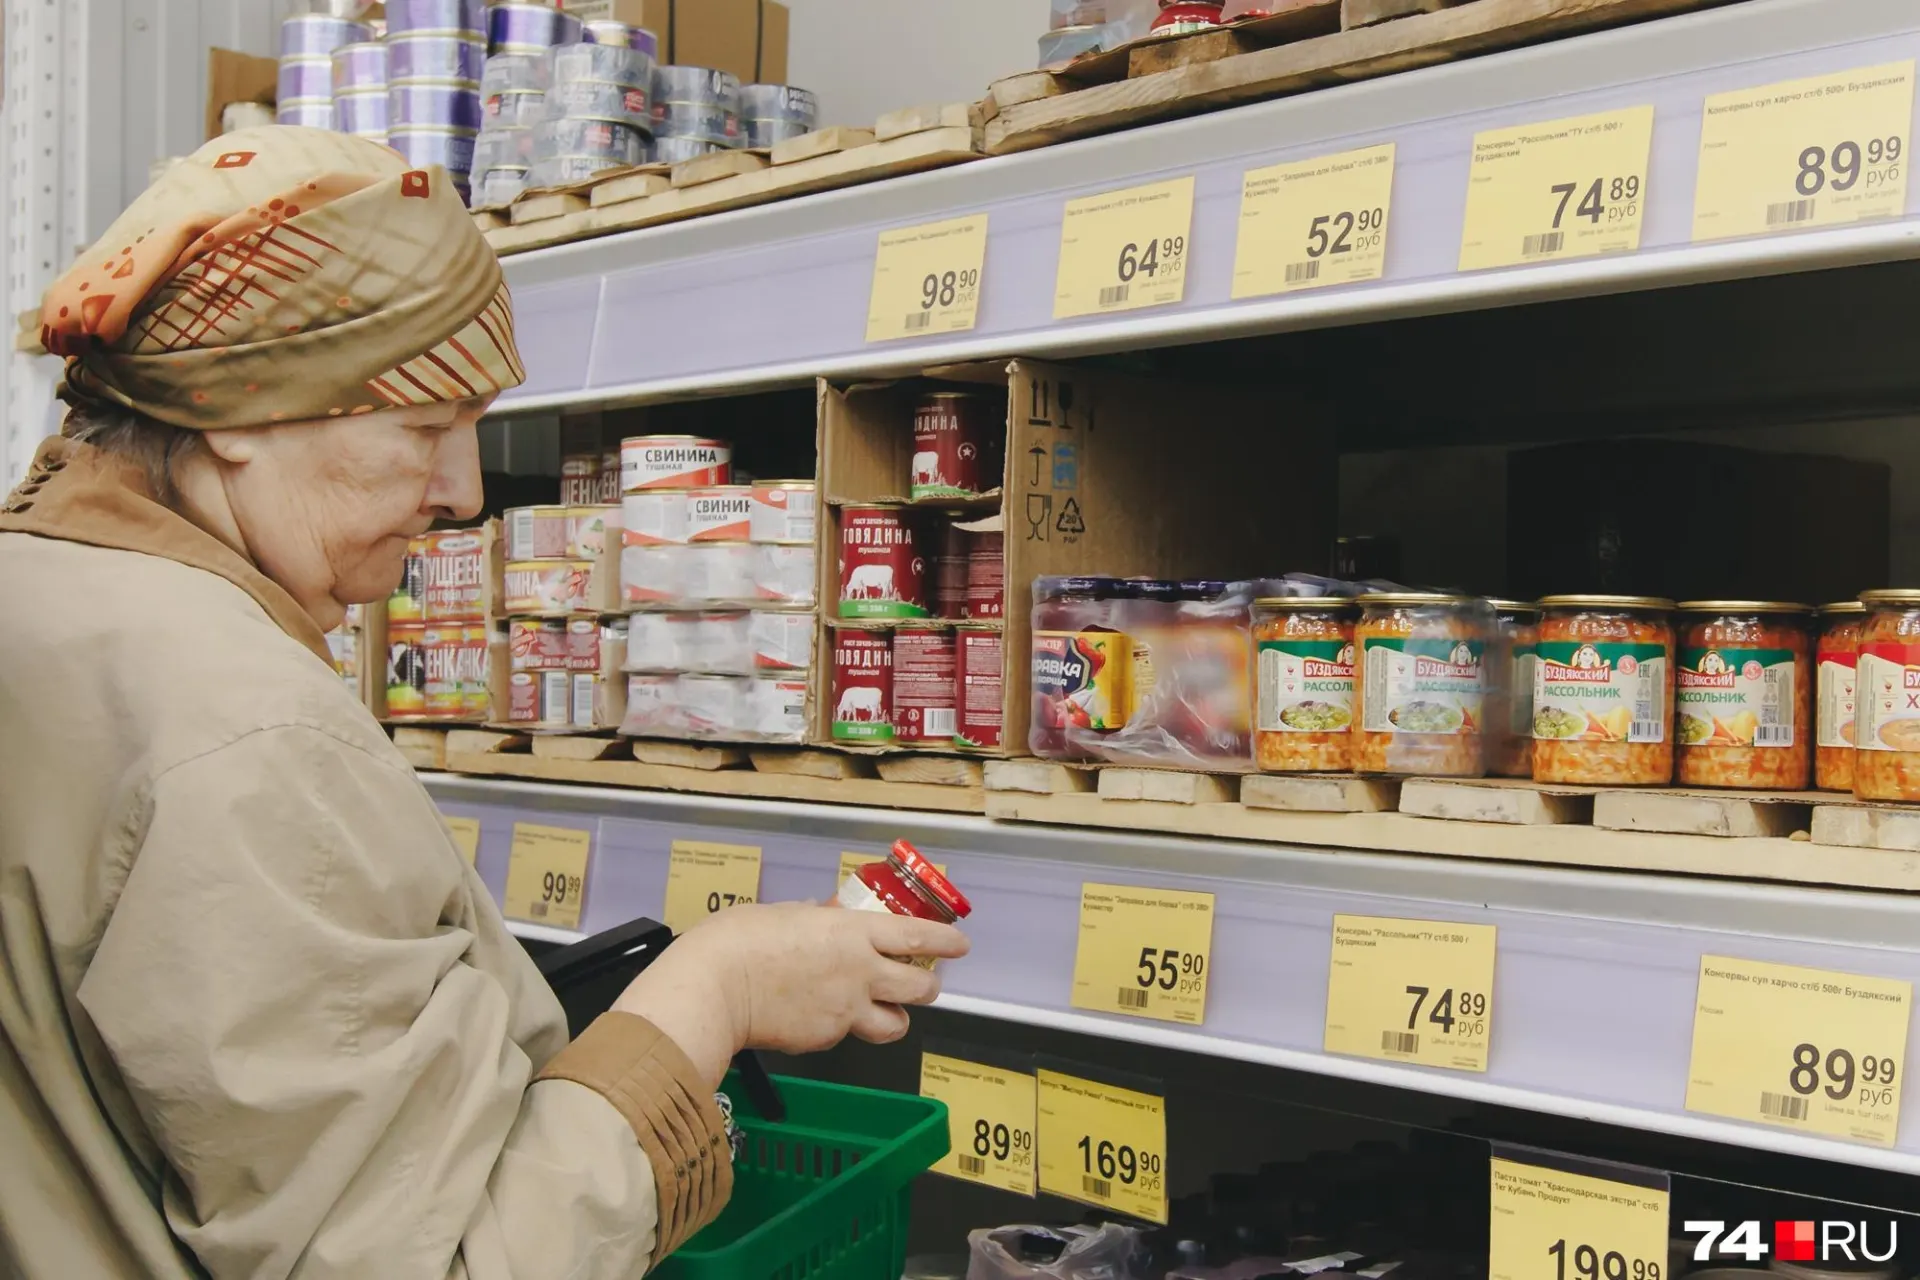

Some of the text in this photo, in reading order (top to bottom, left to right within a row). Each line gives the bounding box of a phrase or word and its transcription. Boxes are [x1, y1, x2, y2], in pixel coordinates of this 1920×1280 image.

[1707, 101, 1753, 116] Консервы
[1755, 98, 1772, 109] суп
[1773, 92, 1802, 105] харчо
[1476, 139, 1516, 151] Консервы
[1795, 135, 1902, 196] 89 99
[1866, 163, 1900, 188] руб
[1551, 175, 1639, 229] 74 89
[1607, 201, 1637, 222] руб
[1306, 207, 1383, 257] 52 90
[1356, 231, 1381, 250] руб
[1118, 236, 1184, 282] 64 99
[1160, 258, 1181, 276] руб
[921, 268, 977, 310] 98 90
[645, 449, 717, 463] СВИНИНА
[1065, 514, 1077, 524] 20
[843, 528, 912, 545] ГОВЯДИНА
[1545, 665, 1608, 681] БУЗДЯКСКИЙ
[1544, 686, 1621, 698] РАССОЛЬНИК
[542, 871, 566, 904] 99
[1336, 926, 1372, 937] Консервы
[1136, 947, 1204, 990] 55 90
[1180, 977, 1202, 994] руб
[1704, 968, 1750, 982] Консервы
[1752, 976, 1769, 986] суп
[1770, 978, 1799, 991] харчо
[1845, 987, 1902, 1003] Буздякский
[1405, 985, 1486, 1034] 74 89
[1458, 1019, 1484, 1038] руб
[1789, 1043, 1896, 1101] 89 99
[1859, 1087, 1893, 1108] руб
[973, 1119, 1032, 1161] 89 90
[1012, 1150, 1031, 1168] руб
[1078, 1135, 1161, 1185] 169 90
[1139, 1174, 1161, 1191] руб
[1494, 1171, 1517, 1184] Паста
[1518, 1176, 1542, 1187] томат
[1507, 1184, 1537, 1199] Кубань
[1537, 1190, 1571, 1205] Продукт
[1548, 1239, 1628, 1280] 199
